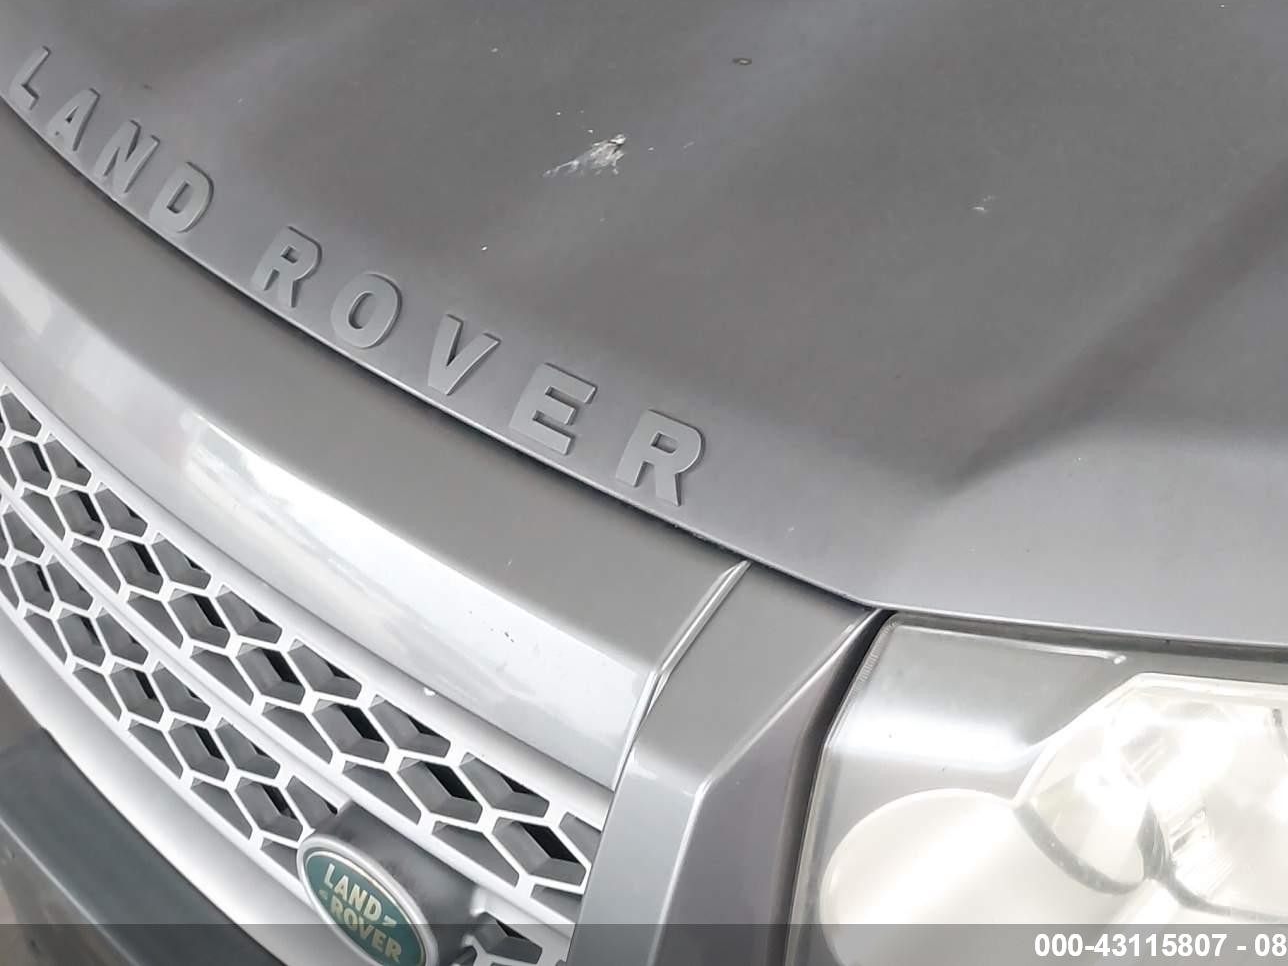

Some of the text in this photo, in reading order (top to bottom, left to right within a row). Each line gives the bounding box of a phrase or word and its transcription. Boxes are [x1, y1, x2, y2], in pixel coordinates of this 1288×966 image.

[10, 45, 704, 506] LAND ROVER
[324, 863, 382, 922] LAND
[330, 895, 402, 962] ROVER
